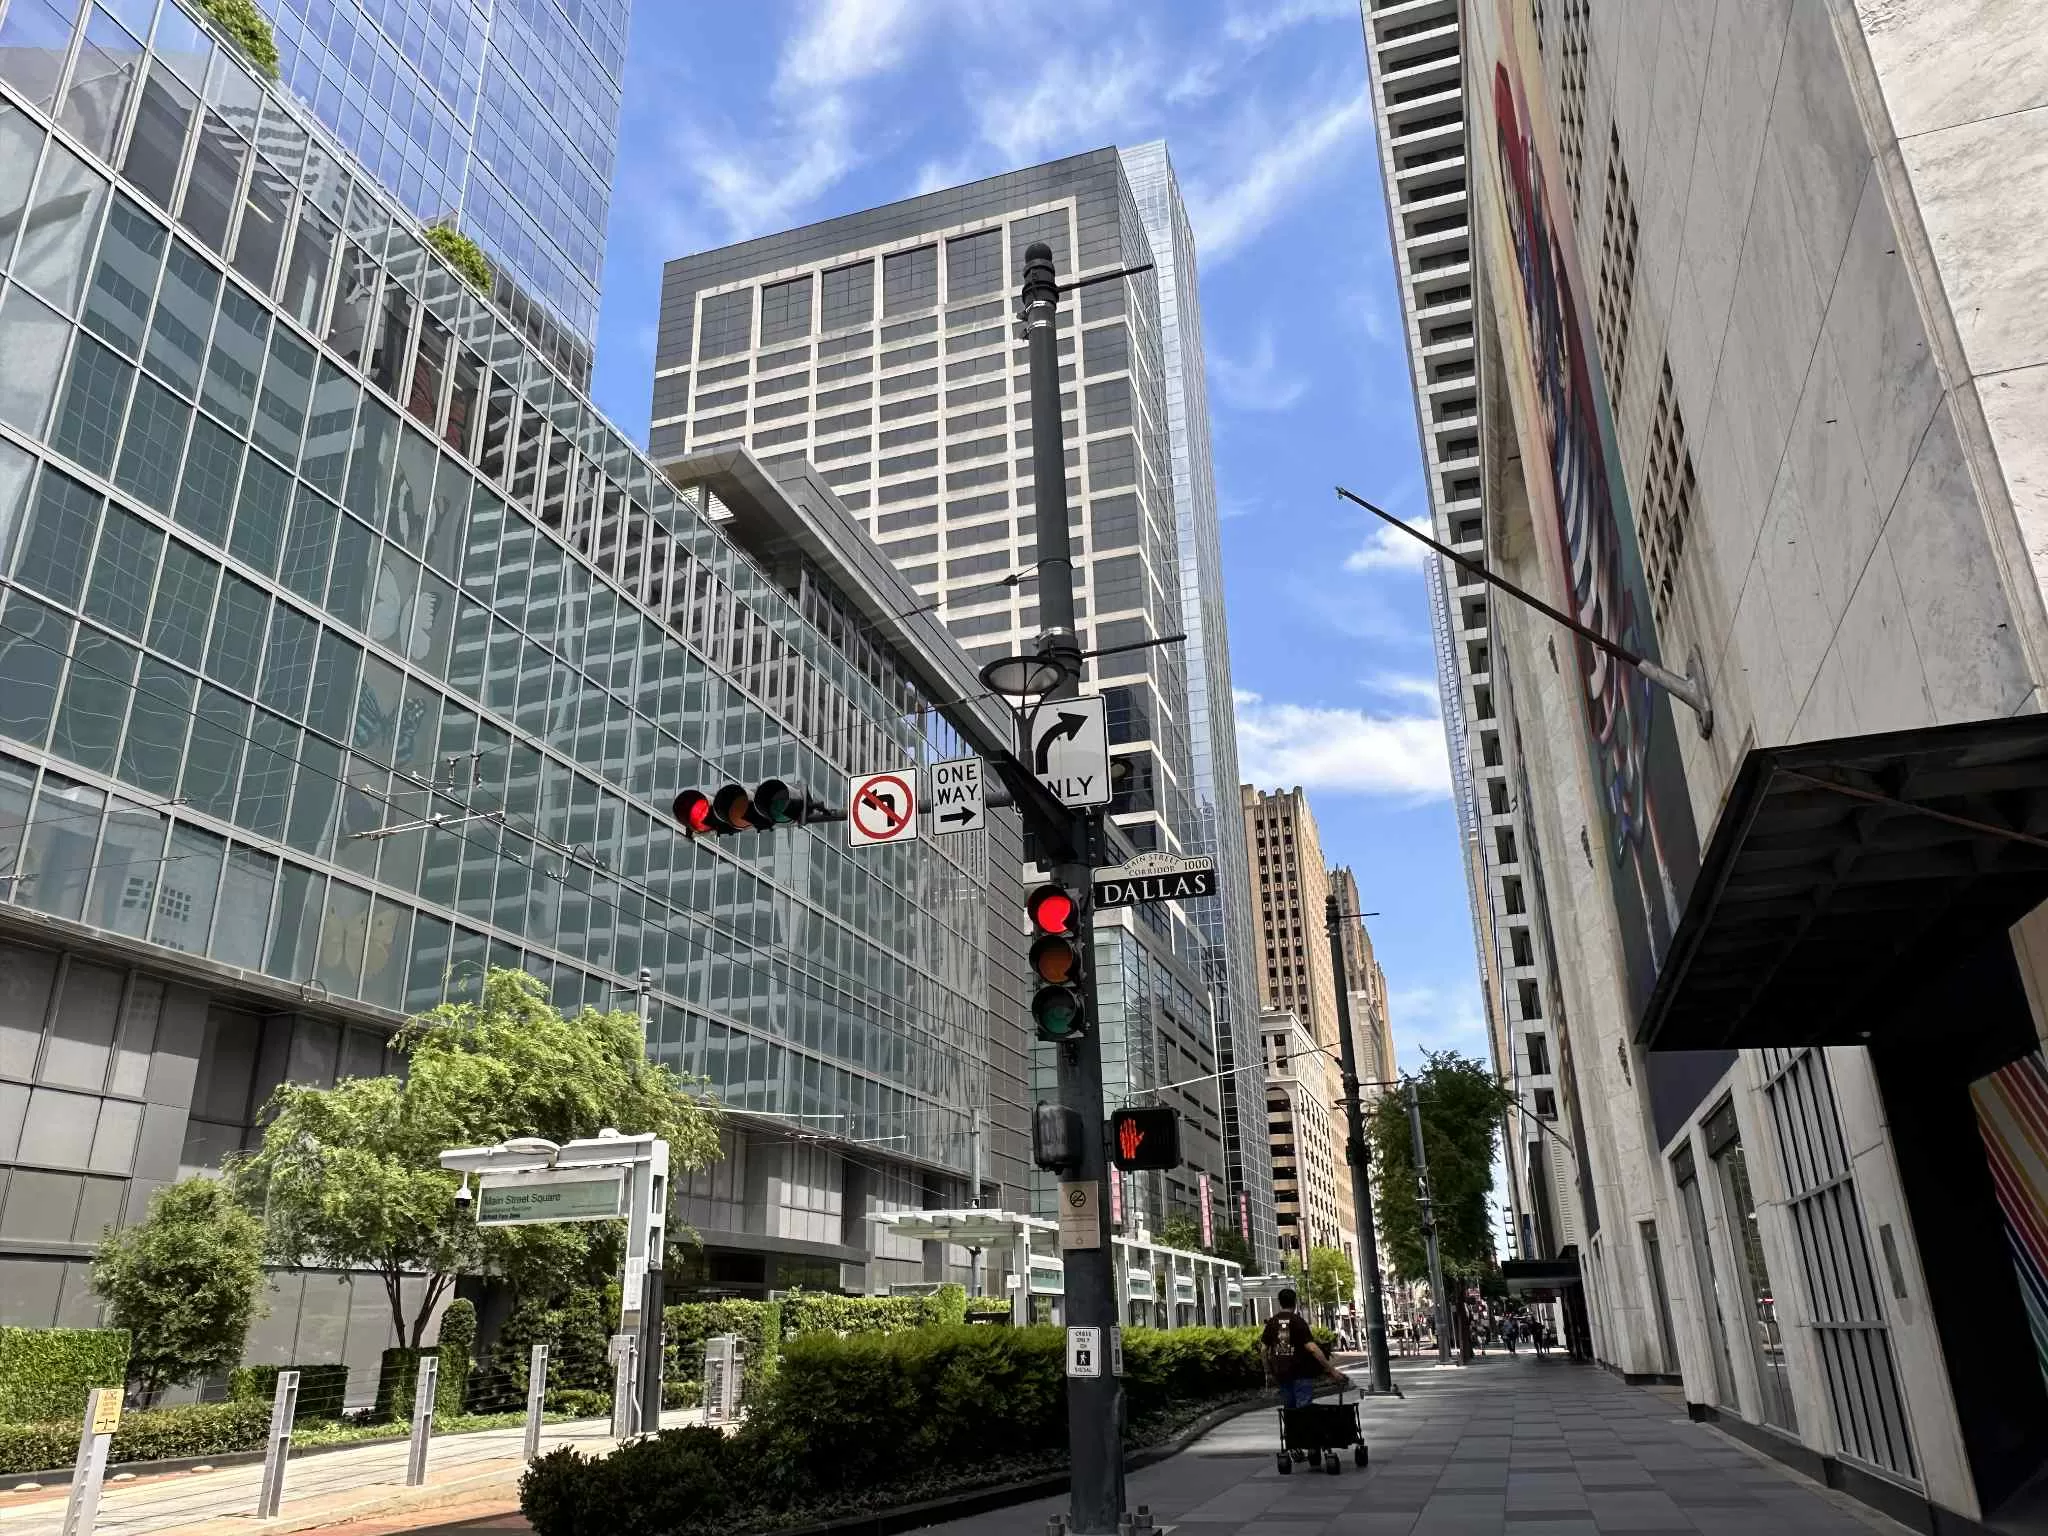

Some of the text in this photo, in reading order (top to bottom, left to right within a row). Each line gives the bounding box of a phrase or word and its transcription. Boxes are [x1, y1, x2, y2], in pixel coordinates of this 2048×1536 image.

[937, 764, 977, 784] ONE
[937, 784, 978, 805] WAY
[1048, 776, 1094, 799] NLY
[1124, 854, 1180, 870] MAIN STREET
[1128, 865, 1176, 877] CORRIDOR
[1184, 859, 1209, 871] 1000
[1103, 874, 1207, 904] DALLAS
[484, 1192, 561, 1206] Main Street Square
